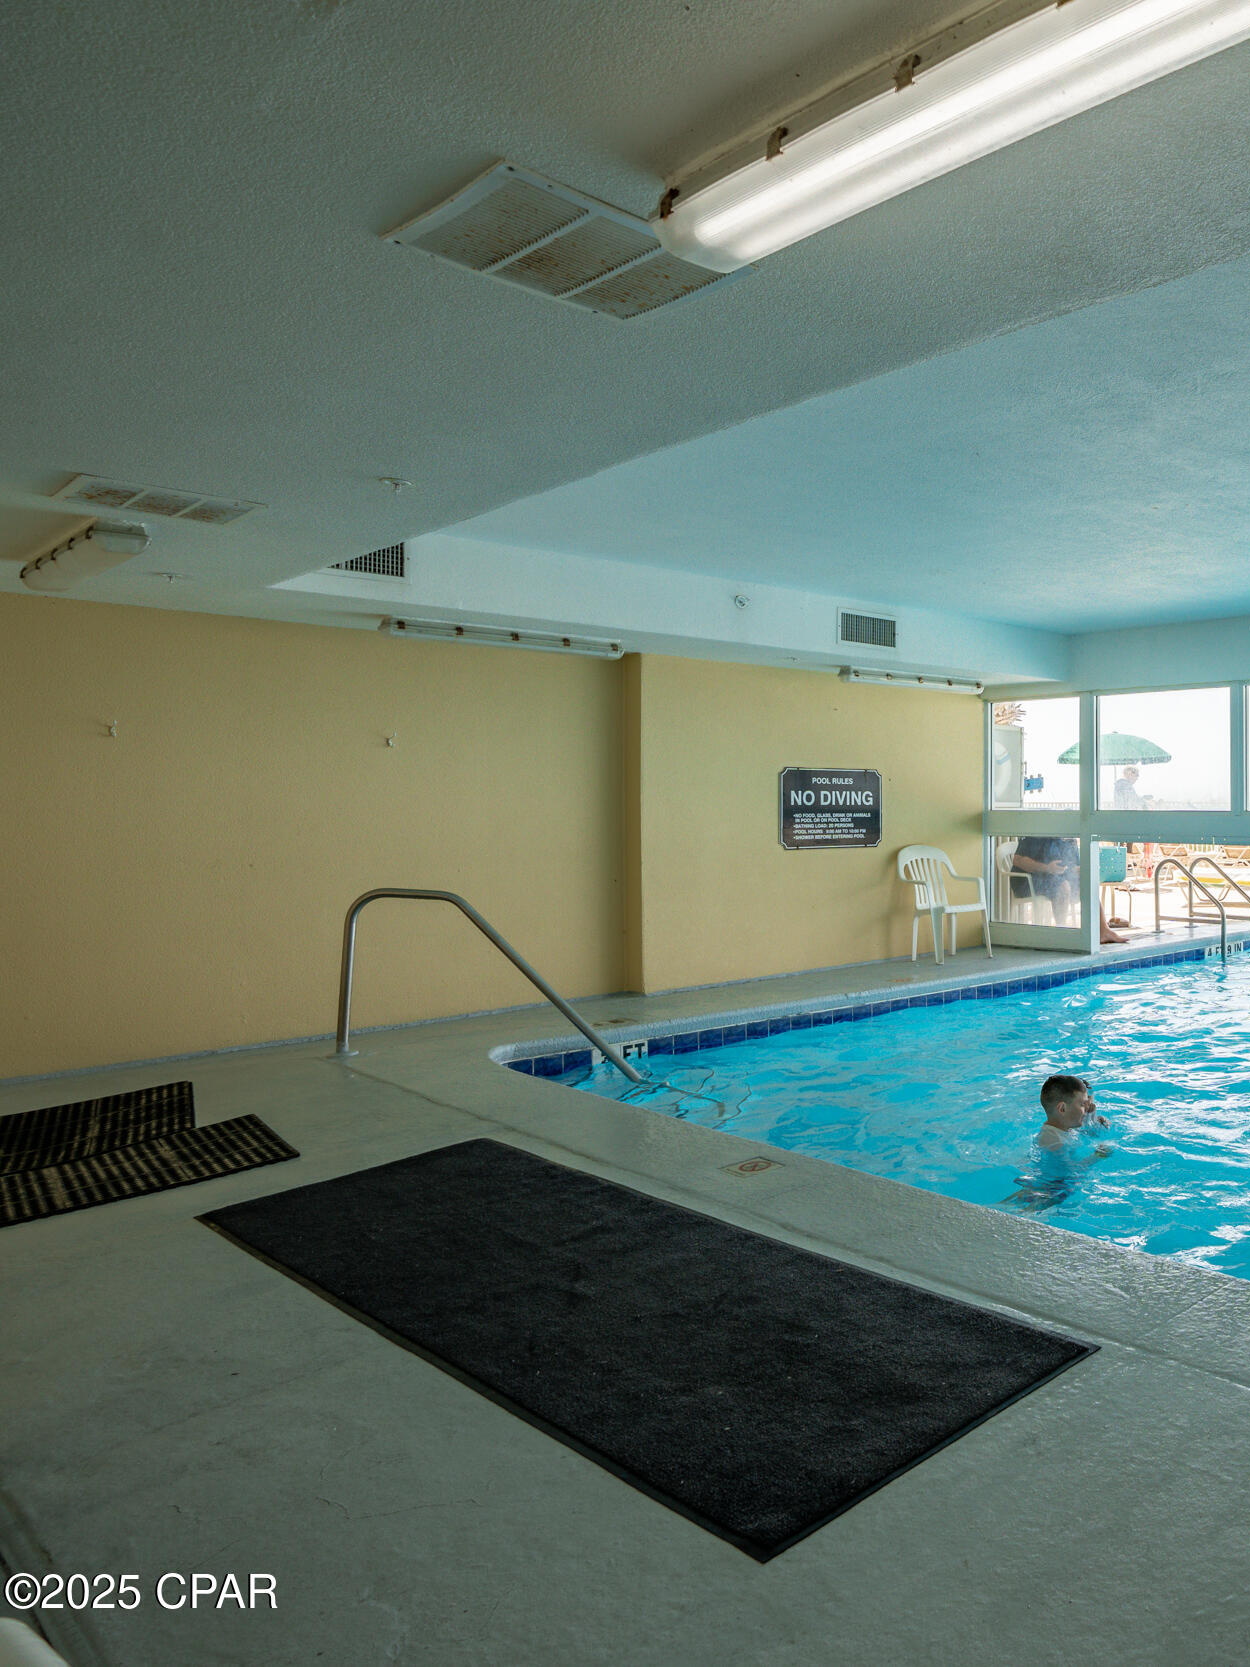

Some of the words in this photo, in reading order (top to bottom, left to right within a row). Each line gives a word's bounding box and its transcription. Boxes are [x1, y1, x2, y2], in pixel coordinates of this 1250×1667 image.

[812, 777, 831, 785] POOL
[832, 777, 854, 785] RULES
[790, 790, 816, 806] NO
[820, 790, 873, 806] DIVING
[623, 1042, 646, 1059] FT
